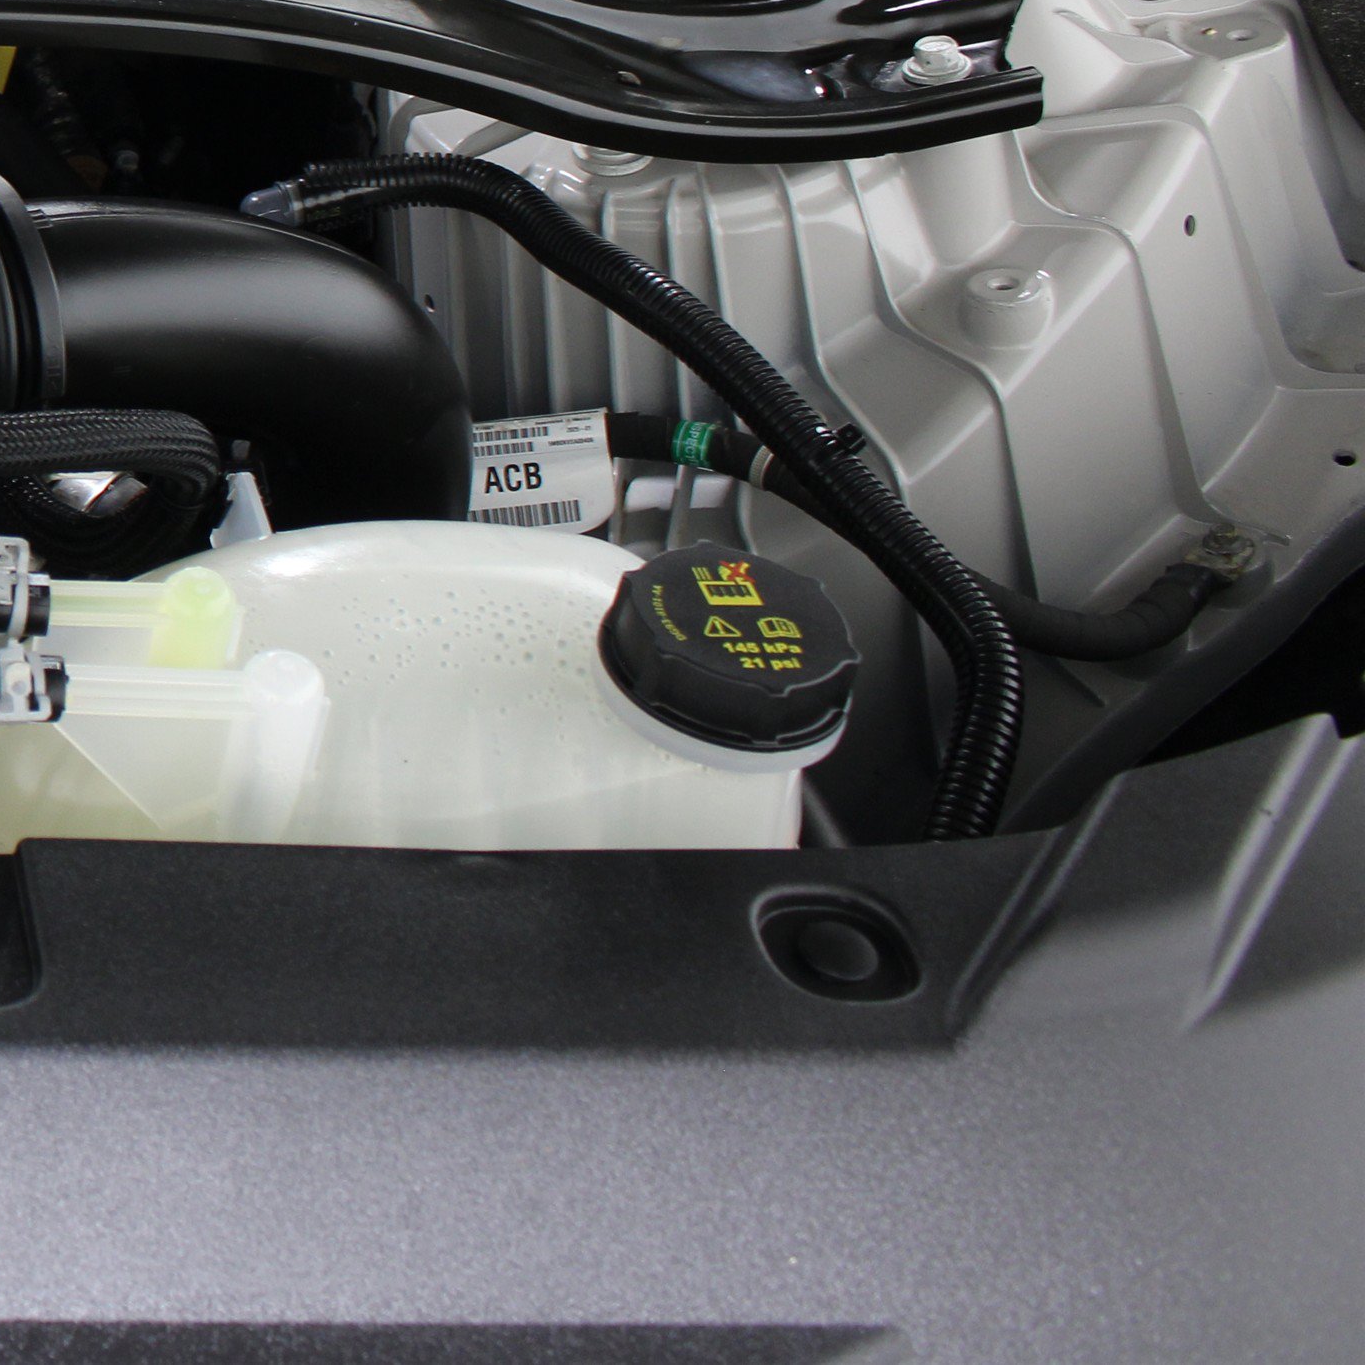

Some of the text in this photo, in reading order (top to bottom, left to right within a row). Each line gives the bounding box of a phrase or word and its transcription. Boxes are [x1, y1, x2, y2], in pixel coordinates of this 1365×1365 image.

[485, 462, 542, 493] ACB
[723, 642, 802, 654] 145 kPa
[740, 658, 802, 670] 21 psi
